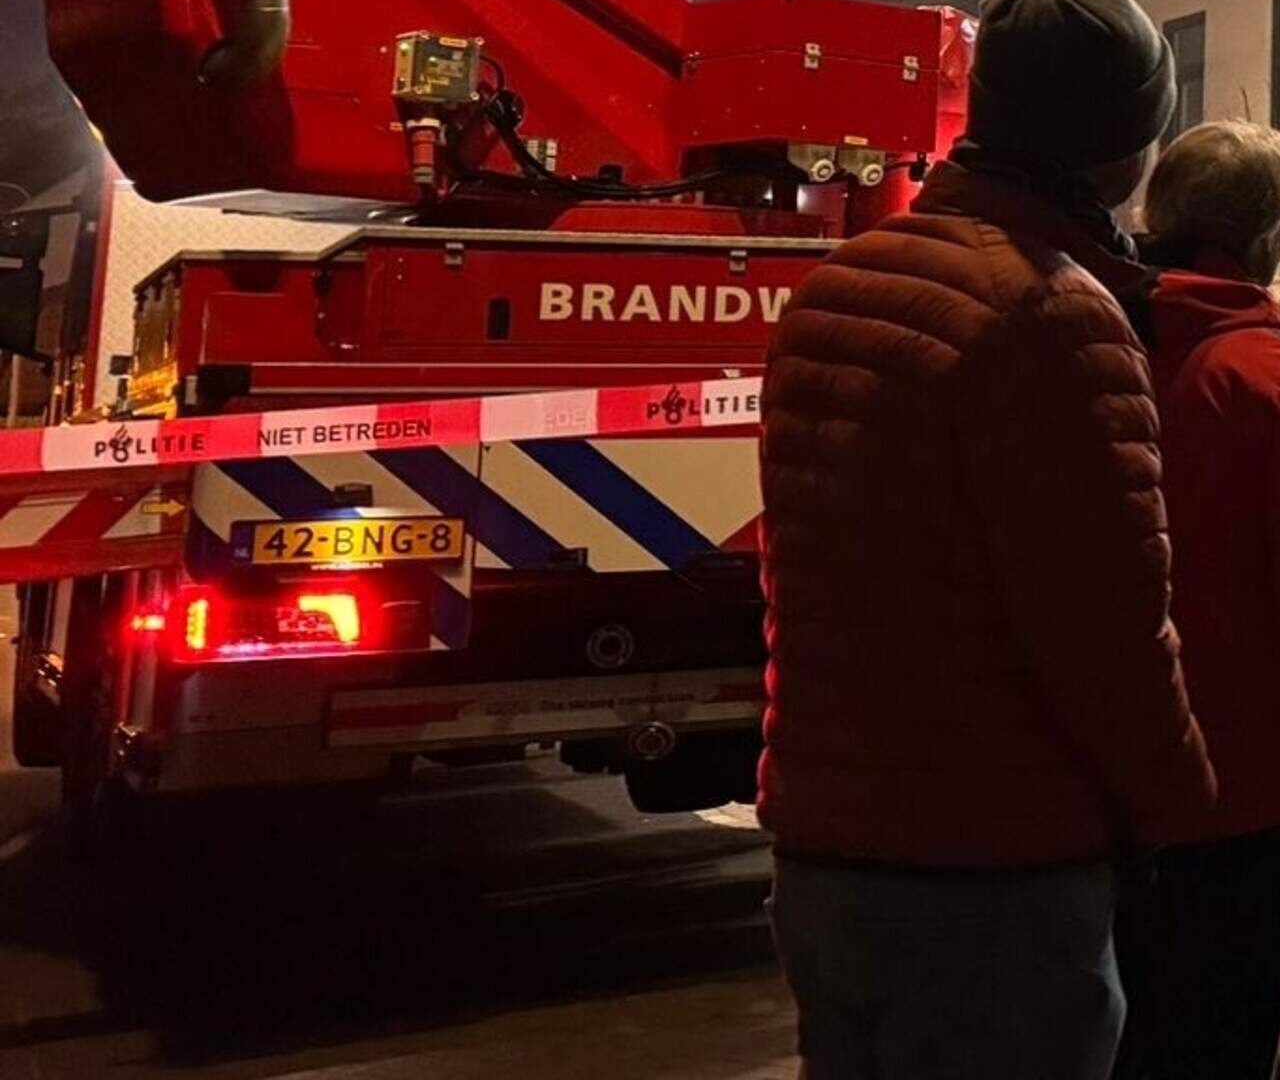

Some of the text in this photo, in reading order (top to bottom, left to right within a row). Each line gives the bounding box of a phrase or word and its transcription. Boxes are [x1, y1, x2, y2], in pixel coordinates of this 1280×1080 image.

[646, 386, 759, 424] POLITIE
[94, 418, 432, 463] POLITIE NIET BETREDEN
[264, 524, 450, 557] 42-BNG-8
